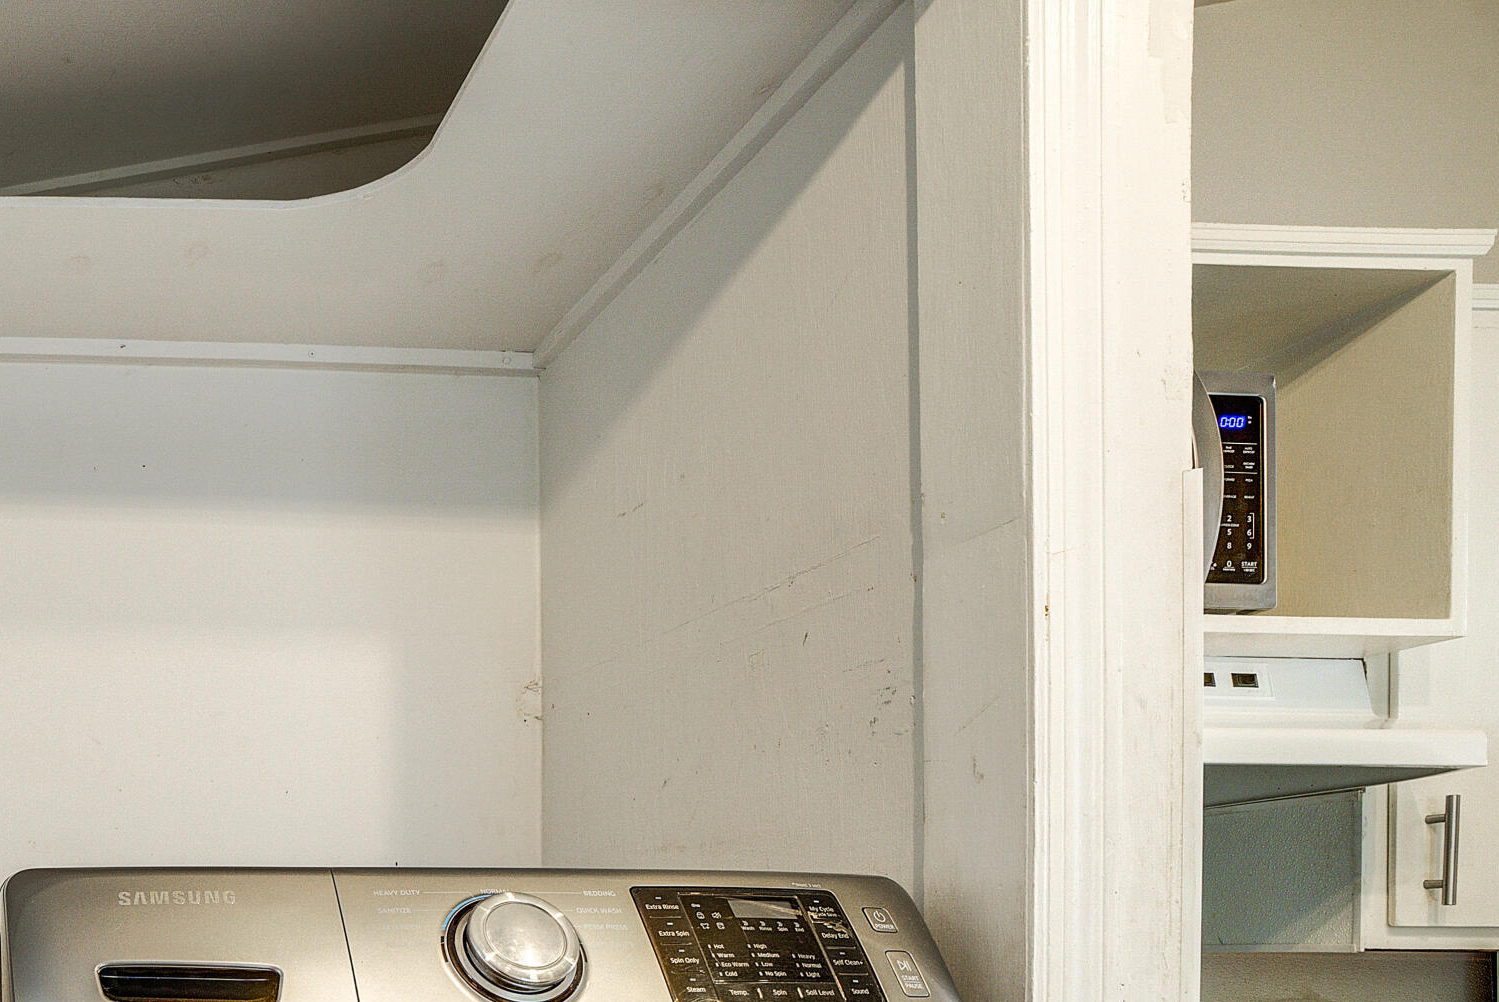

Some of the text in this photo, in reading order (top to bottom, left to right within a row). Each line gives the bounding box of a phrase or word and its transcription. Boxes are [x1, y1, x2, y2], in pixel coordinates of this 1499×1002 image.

[1247, 515, 1252, 523] 3
[1227, 542, 1232, 550] 8
[1247, 542, 1252, 550] 9
[1227, 560, 1232, 568] 0
[118, 890, 236, 906] SAMSUNG
[809, 905, 818, 913] My
[676, 930, 690, 938] Spin
[822, 932, 838, 940] Delay
[685, 957, 700, 965] Only
[773, 989, 788, 997] Spin
